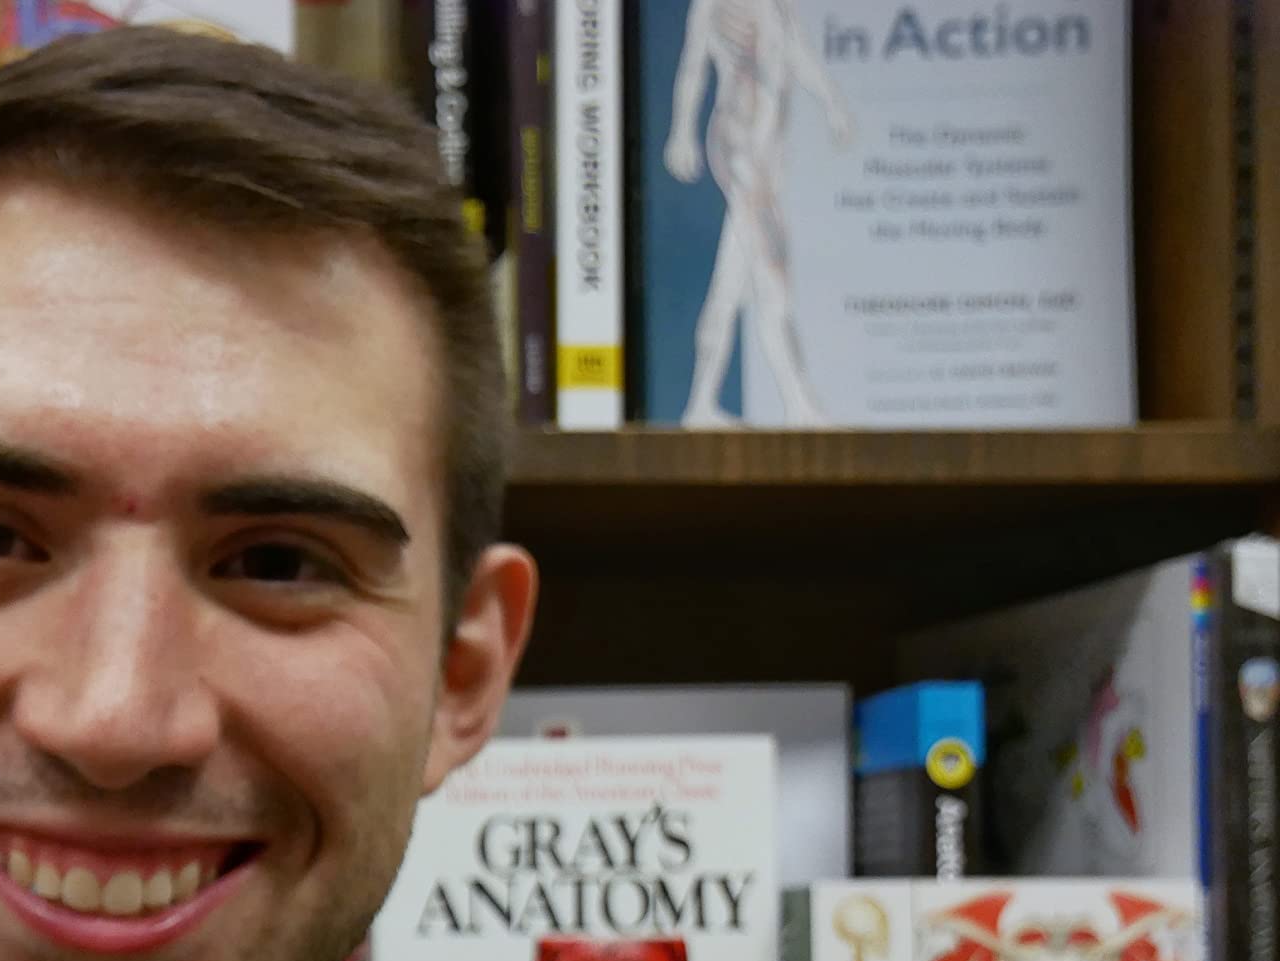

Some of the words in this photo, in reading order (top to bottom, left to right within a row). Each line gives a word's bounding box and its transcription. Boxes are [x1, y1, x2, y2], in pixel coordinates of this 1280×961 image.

[577, 0, 602, 92] ORING
[824, 12, 869, 61] in
[884, 3, 1091, 60] Action
[579, 103, 602, 293] WORKBOOK
[477, 803, 693, 875] GRAY'S
[418, 873, 754, 935] ANATOMY
